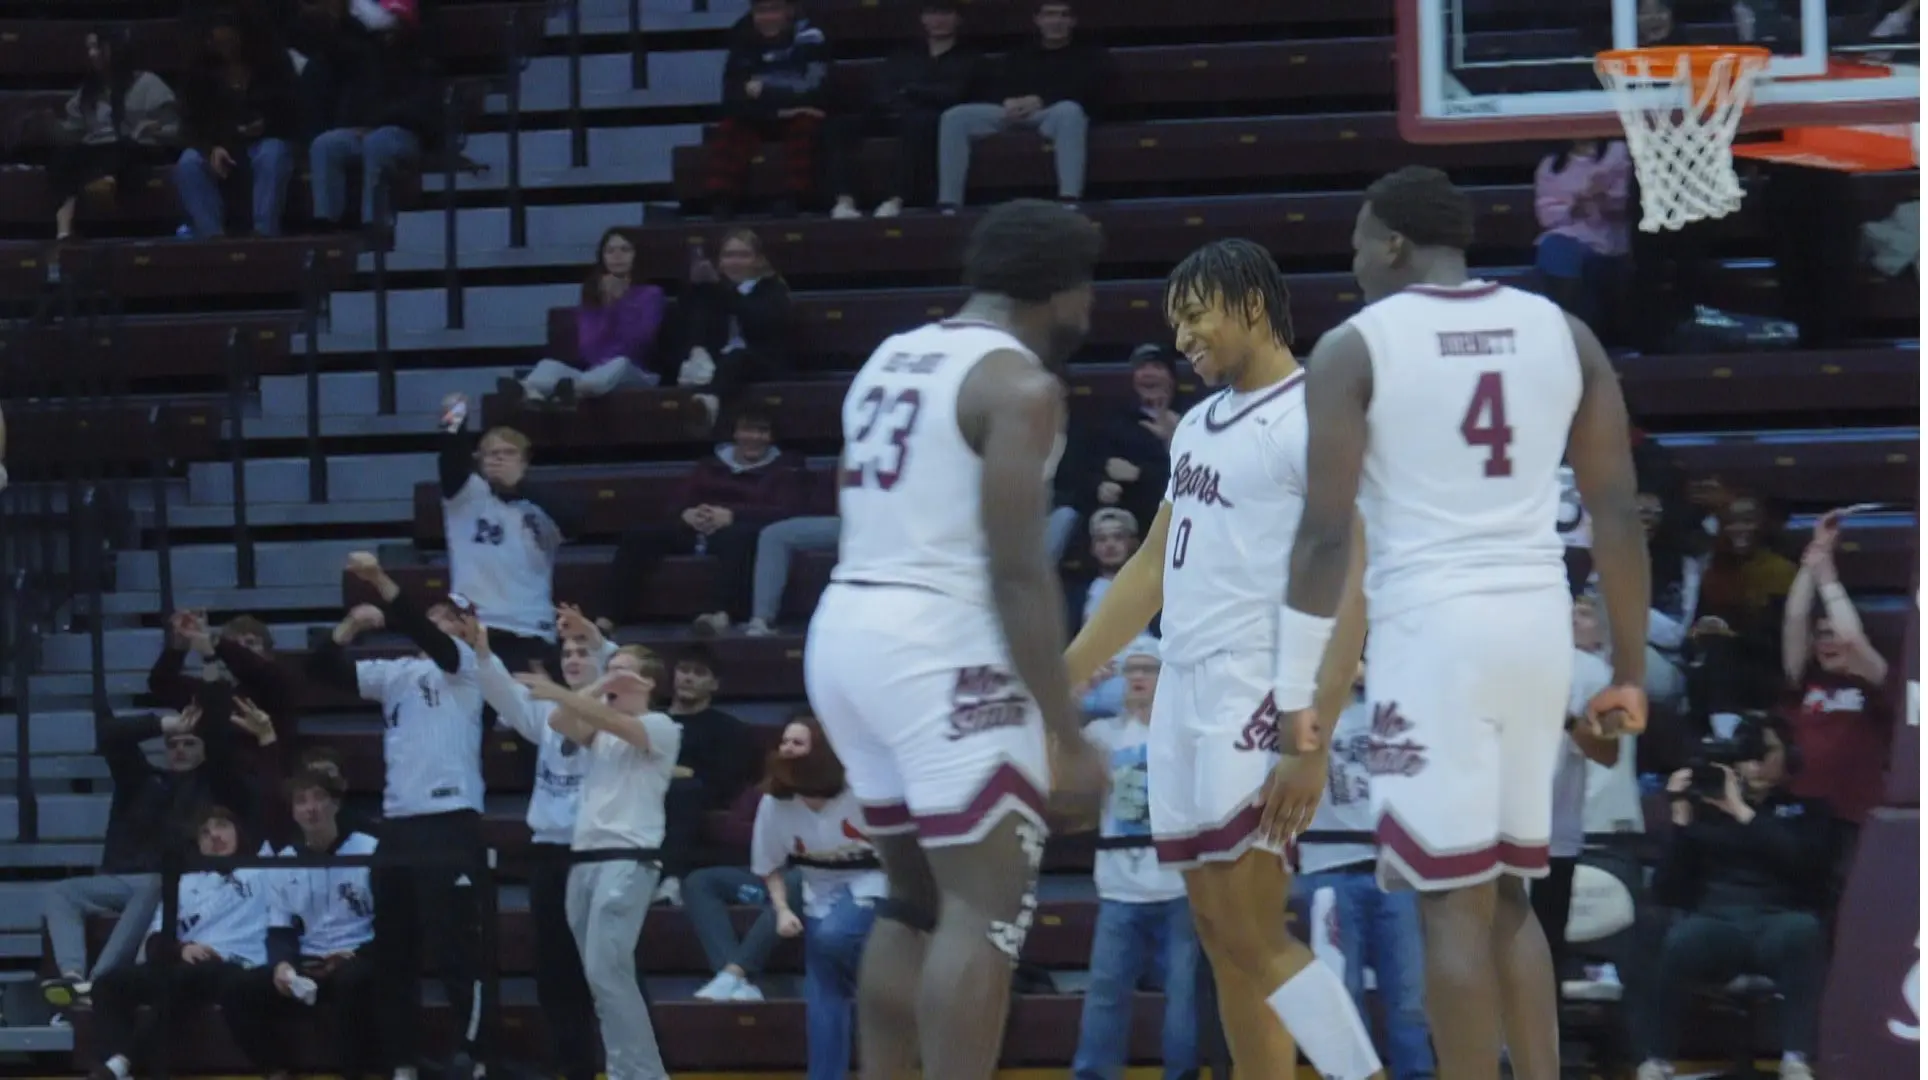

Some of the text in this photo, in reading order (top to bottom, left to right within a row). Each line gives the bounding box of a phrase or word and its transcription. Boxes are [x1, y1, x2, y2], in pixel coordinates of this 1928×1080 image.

[842, 386, 921, 491] 23
[1460, 370, 1513, 477] 4
[1172, 451, 1234, 508] Bears
[1172, 517, 1192, 570] 0
